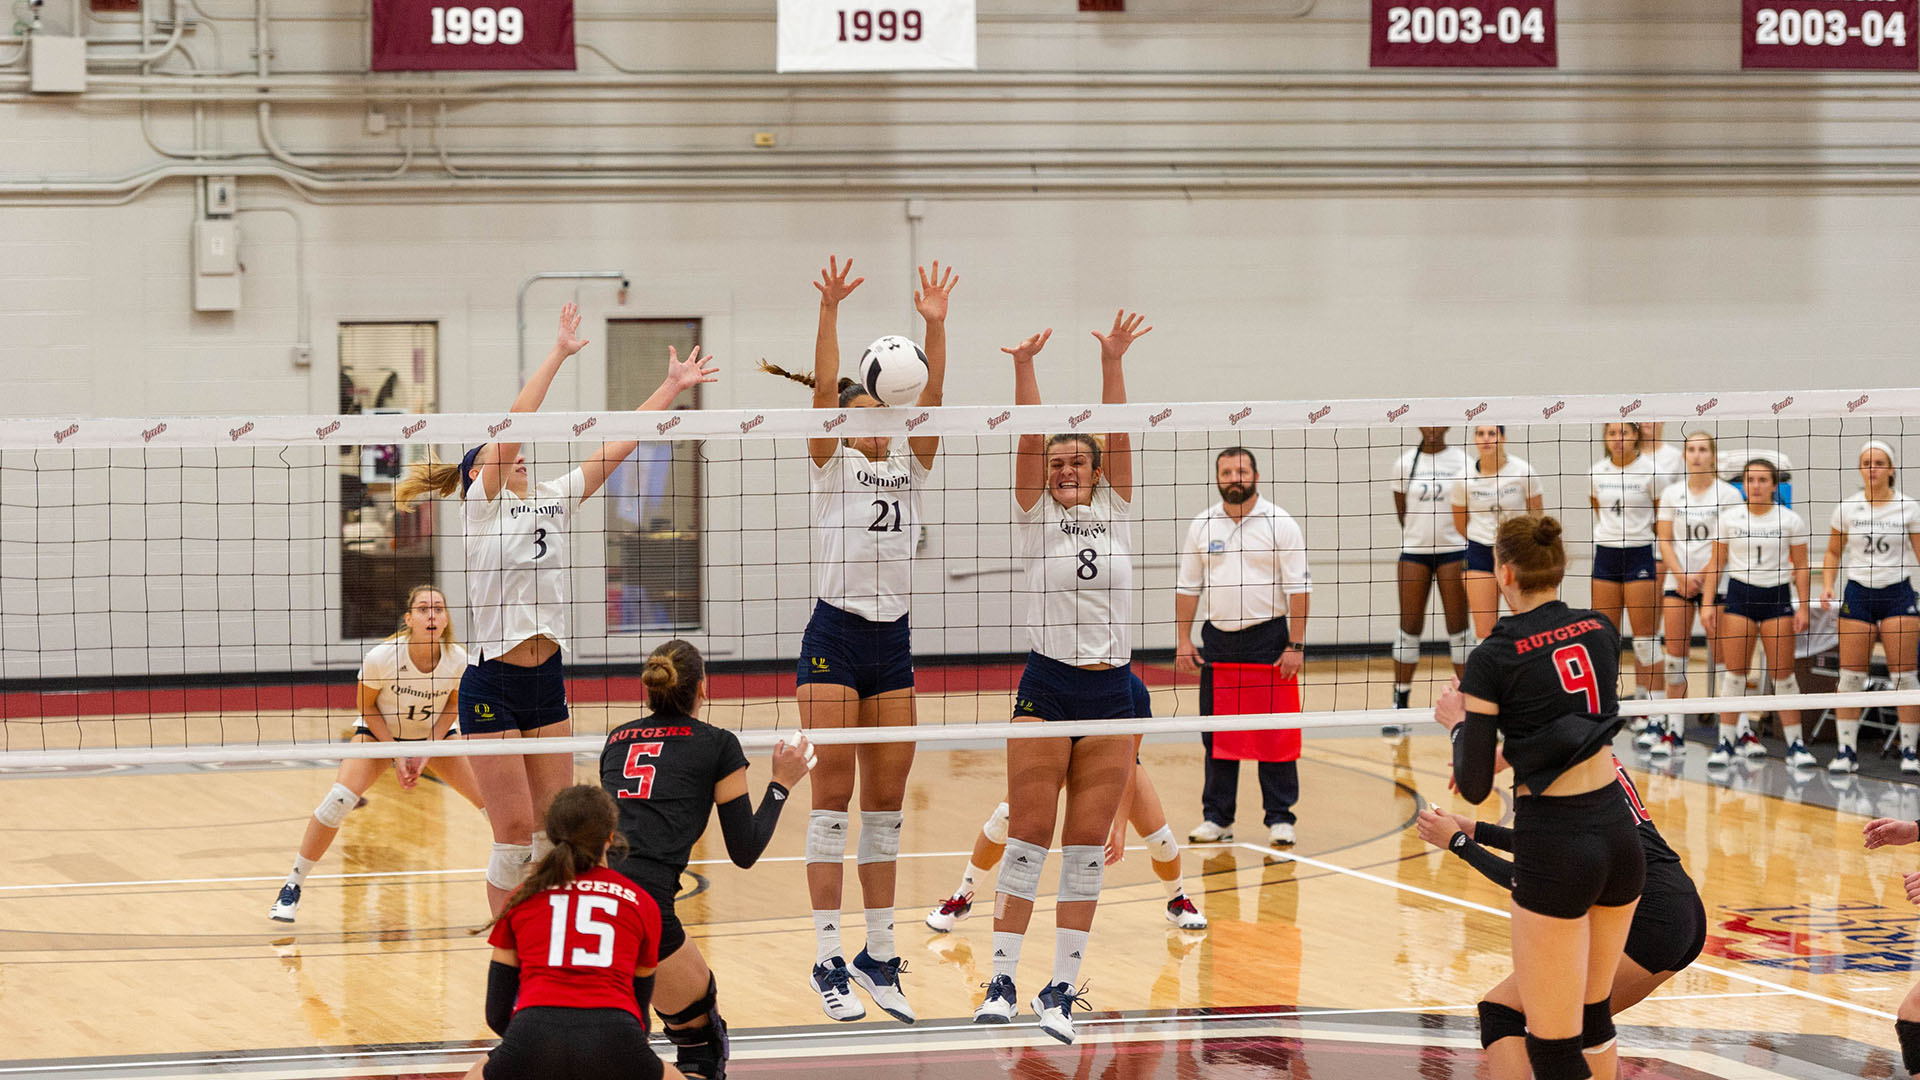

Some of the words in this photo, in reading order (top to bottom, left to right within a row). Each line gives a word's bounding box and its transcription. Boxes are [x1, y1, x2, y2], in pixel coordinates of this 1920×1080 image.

[431, 7, 523, 45] 1999
[837, 10, 922, 42] 1999
[1387, 7, 1544, 44] 2003-04
[1756, 9, 1906, 47] 2003-04
[1419, 483, 1445, 501] 22
[1610, 498, 1622, 517] 4
[867, 499, 902, 533] 21
[531, 528, 548, 560] 3
[1863, 535, 1890, 554] 26
[1077, 548, 1098, 580] 8
[1515, 619, 1603, 655] RUTGERS
[1551, 643, 1601, 714] 9
[405, 704, 433, 722] 15
[609, 726, 693, 744] RUTGERS
[617, 741, 664, 800] 5
[547, 894, 619, 968] 15
